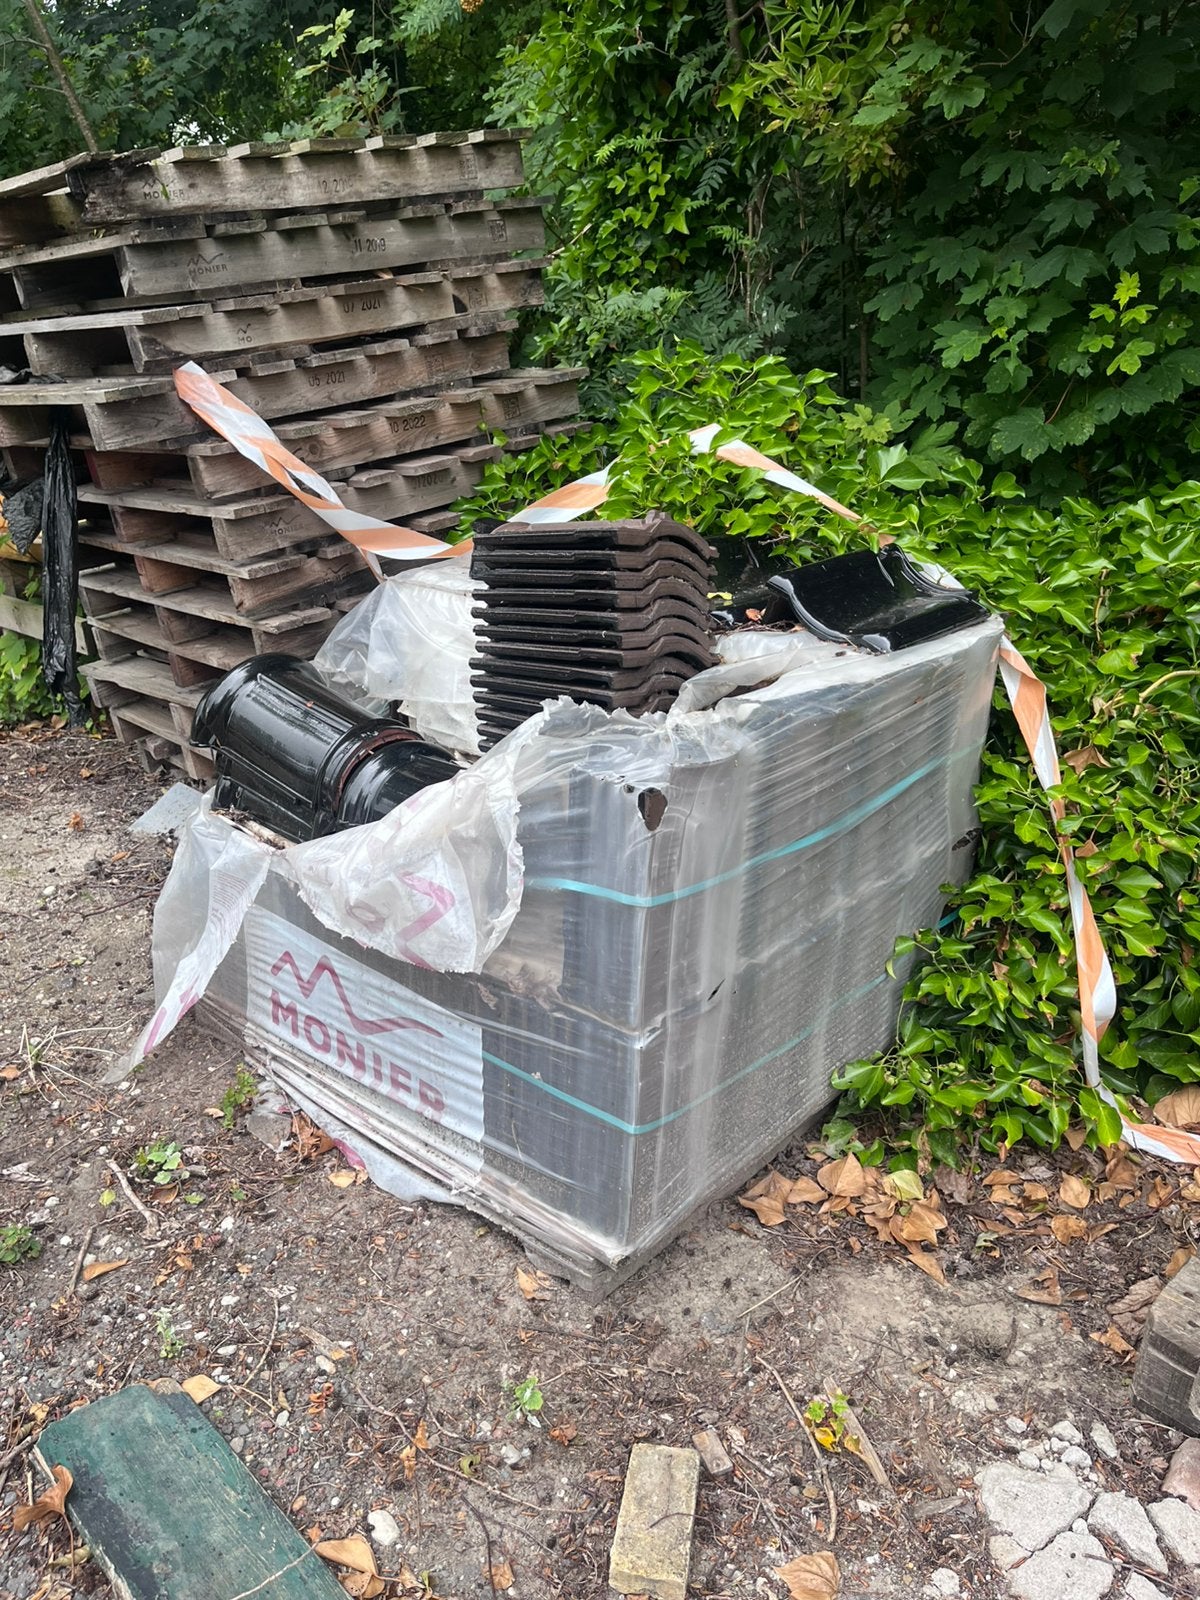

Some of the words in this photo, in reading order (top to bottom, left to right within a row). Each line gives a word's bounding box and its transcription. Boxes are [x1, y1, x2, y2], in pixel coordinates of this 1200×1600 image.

[354, 238, 363, 252] 11
[366, 237, 386, 252] 2019
[188, 263, 228, 276] MONIER
[361, 298, 381, 311] 2021
[325, 369, 346, 385] 2021
[389, 421, 400, 434] 10
[402, 414, 426, 431] 2022
[270, 988, 446, 1121] MONIER
